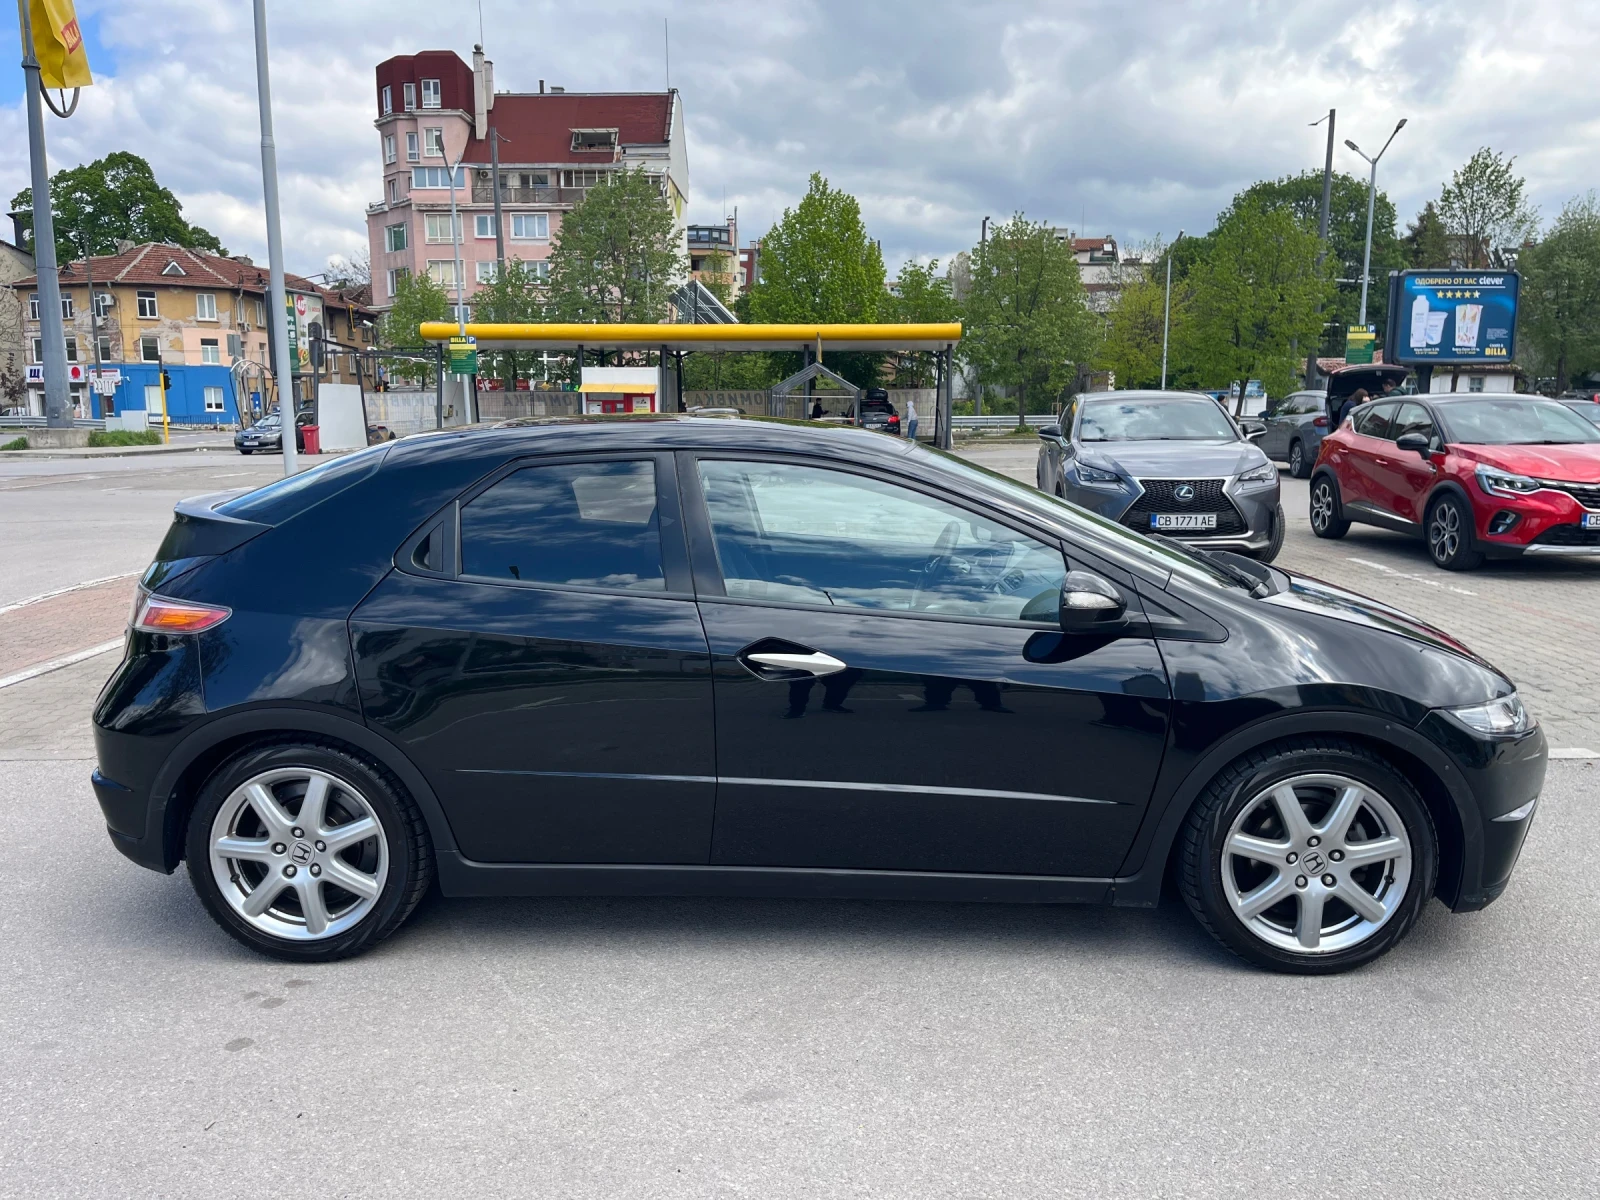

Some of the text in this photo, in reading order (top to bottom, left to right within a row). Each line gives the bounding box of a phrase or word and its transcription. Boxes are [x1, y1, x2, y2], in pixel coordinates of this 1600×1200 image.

[1479, 276, 1504, 285] clever
[1485, 347, 1507, 356] BILLA
[1158, 516, 1171, 526] CB
[1175, 516, 1198, 526] 1771
[1201, 516, 1214, 526] AE
